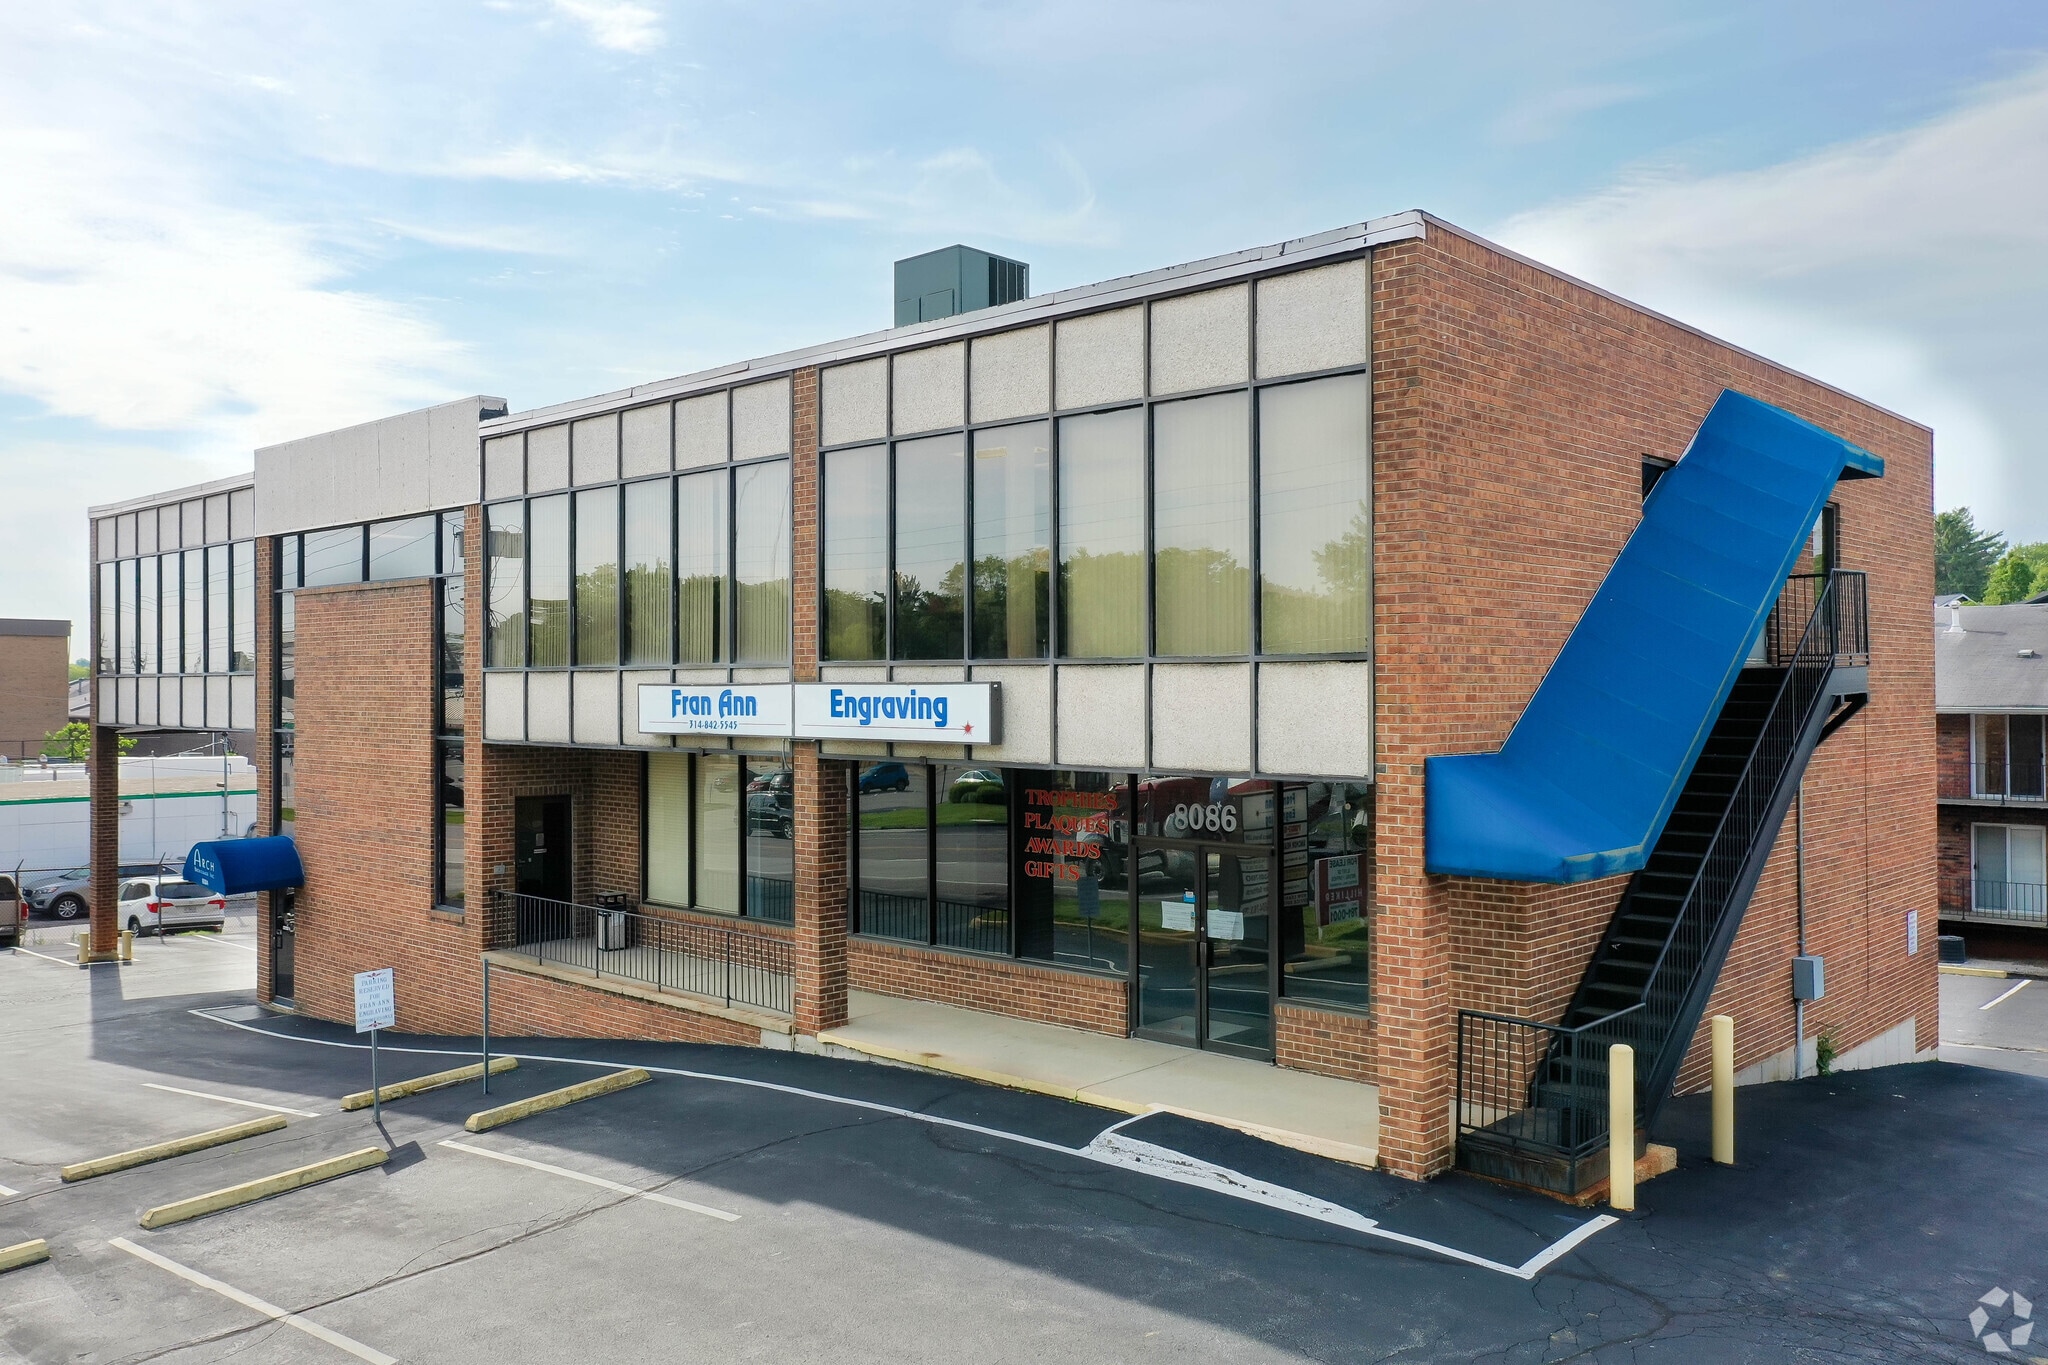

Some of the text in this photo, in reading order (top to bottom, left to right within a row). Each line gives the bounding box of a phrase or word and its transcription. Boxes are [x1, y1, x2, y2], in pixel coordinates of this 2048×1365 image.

[671, 689, 757, 718] Fran Ann
[830, 689, 948, 728] Engraving
[689, 719, 738, 730] 314-842-5545
[1024, 788, 1119, 811] TROPHIES
[1024, 812, 1109, 835] PLAQUES
[1174, 803, 1237, 833] 8086
[1024, 836, 1101, 859] AWARDS
[1024, 860, 1080, 881] GIFTS
[359, 985, 389, 994] RESERVED
[361, 978, 387, 986] PARKING
[359, 1006, 391, 1017] ENGRAVING
[360, 1001, 375, 1009] FRAN
